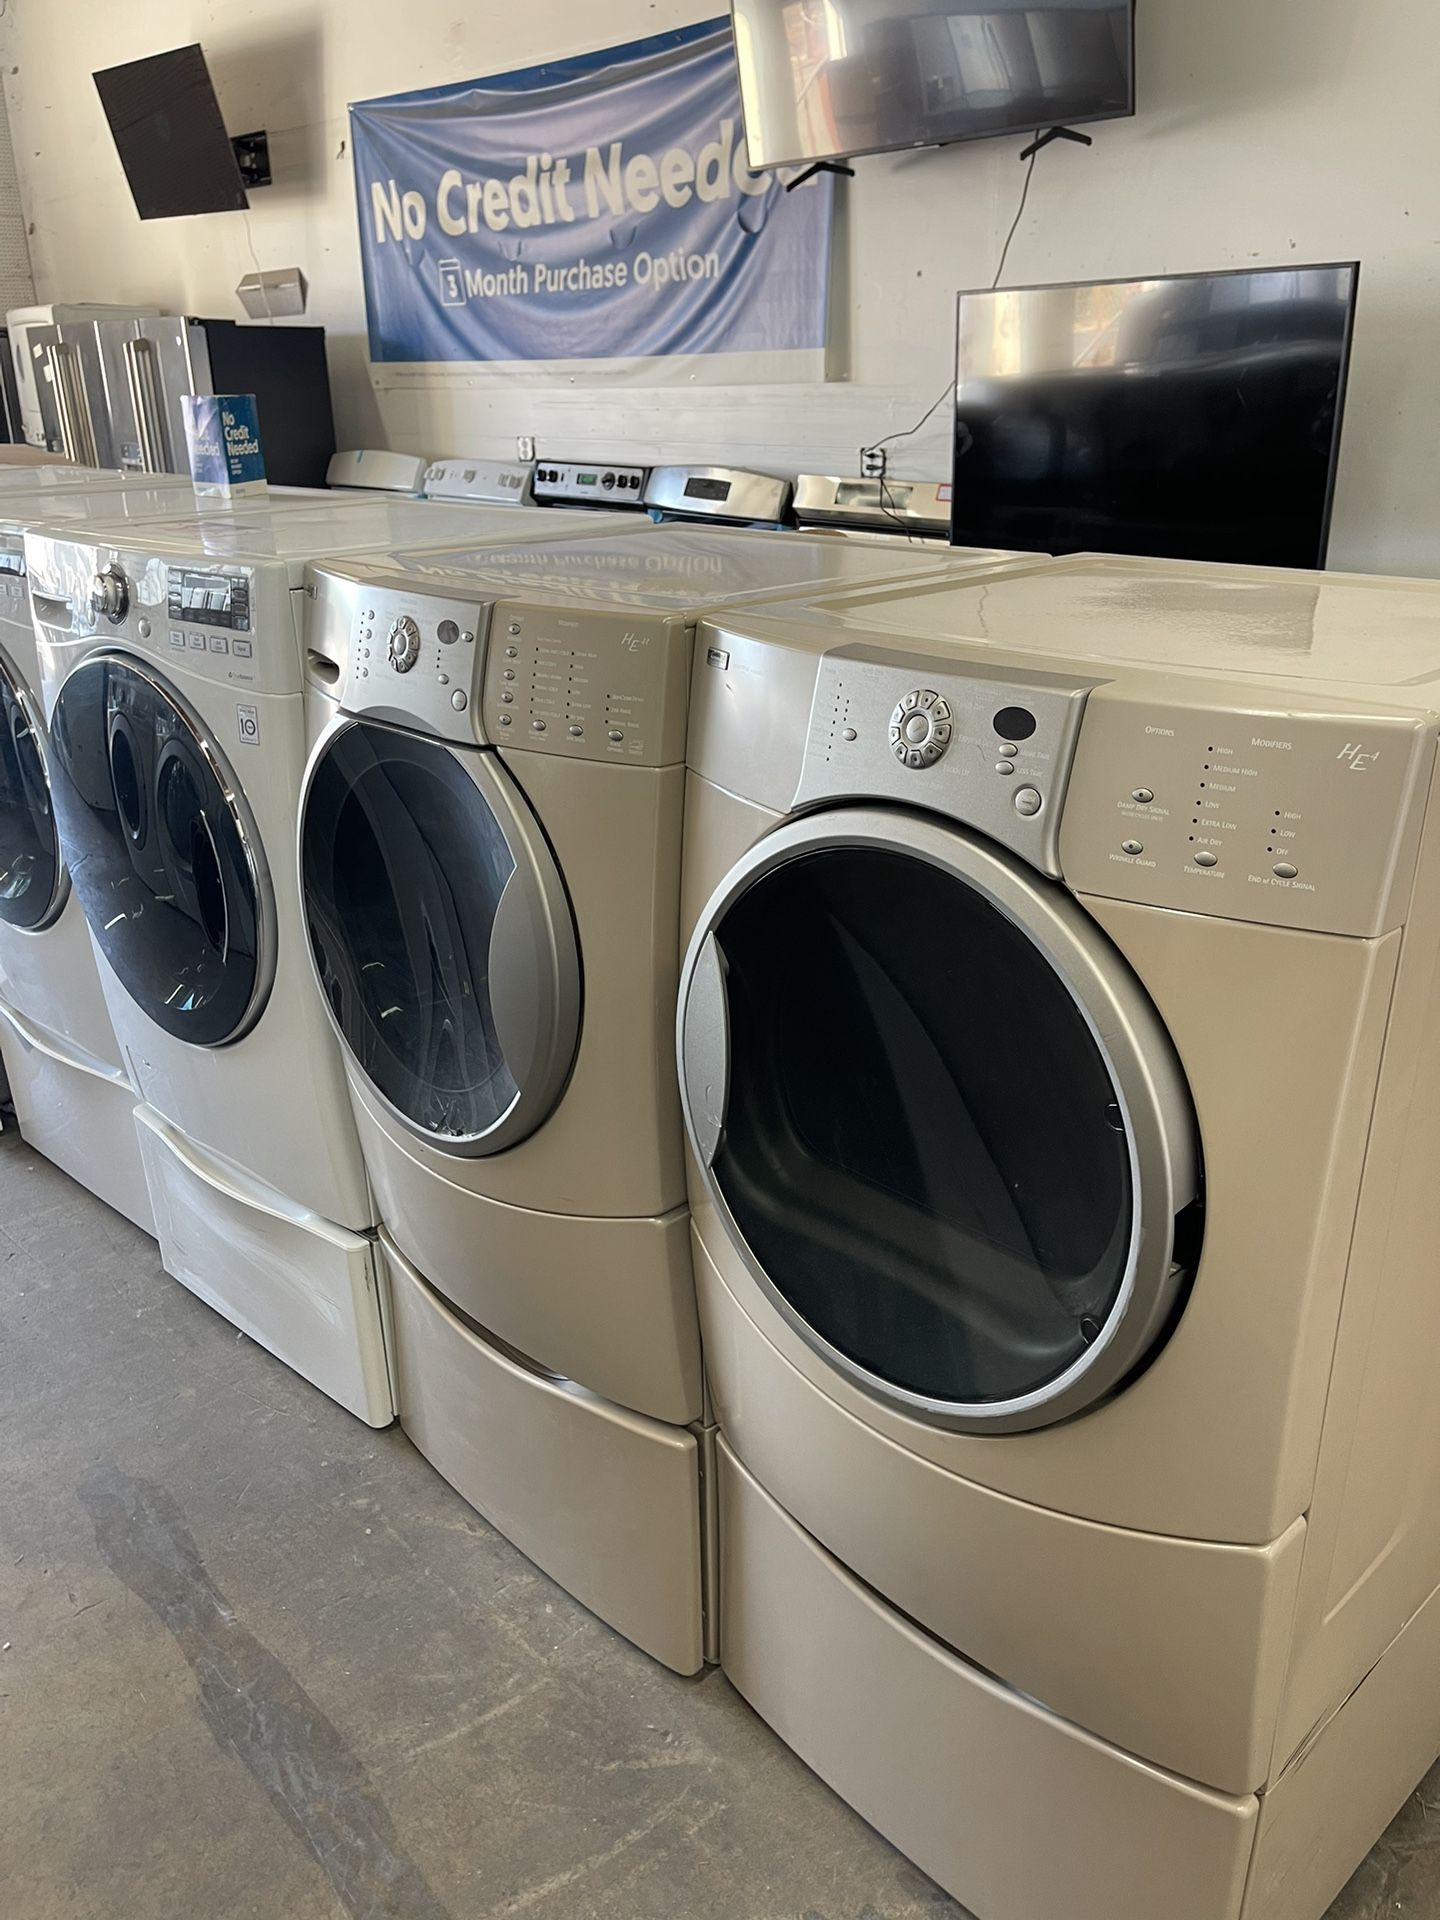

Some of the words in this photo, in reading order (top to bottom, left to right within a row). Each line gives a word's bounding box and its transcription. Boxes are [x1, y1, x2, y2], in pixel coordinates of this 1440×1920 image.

[371, 178, 426, 244] No
[437, 152, 576, 237] Credit
[447, 274, 458, 298] 3
[464, 263, 529, 298] Month
[534, 258, 628, 293] Purchase
[633, 247, 720, 291] Option
[222, 411, 235, 426] No
[224, 425, 249, 441] Credit
[226, 439, 259, 456] Needed
[240, 717, 256, 736] 10
[1145, 725, 1175, 737] OPTIONS
[1251, 737, 1293, 750] MODIFIERS
[1217, 747, 1234, 756] HIGH
[1213, 764, 1240, 775] MEDIUM
[1241, 768, 1258, 777] HIGH
[1209, 783, 1236, 793] MEDIUM
[1135, 803, 1149, 812] DRY
[1149, 805, 1170, 816] SIGNAL
[1205, 801, 1220, 809] LOW
[1284, 811, 1301, 820] HIGH
[1201, 819, 1220, 828] EXTRA
[1222, 821, 1238, 830] LOW
[1280, 830, 1296, 838] LOW
[1197, 836, 1209, 845] AIR
[1209, 838, 1223, 847] DRY
[1276, 847, 1289, 856] OFF
[1109, 853, 1134, 865] WRINKLE
[1135, 858, 1157, 868] GUARD
[1183, 865, 1225, 879] TEMPERATURE
[1247, 874, 1261, 884] END
[1270, 878, 1290, 888] CYCLE
[1292, 881, 1315, 892] SIGNAL
